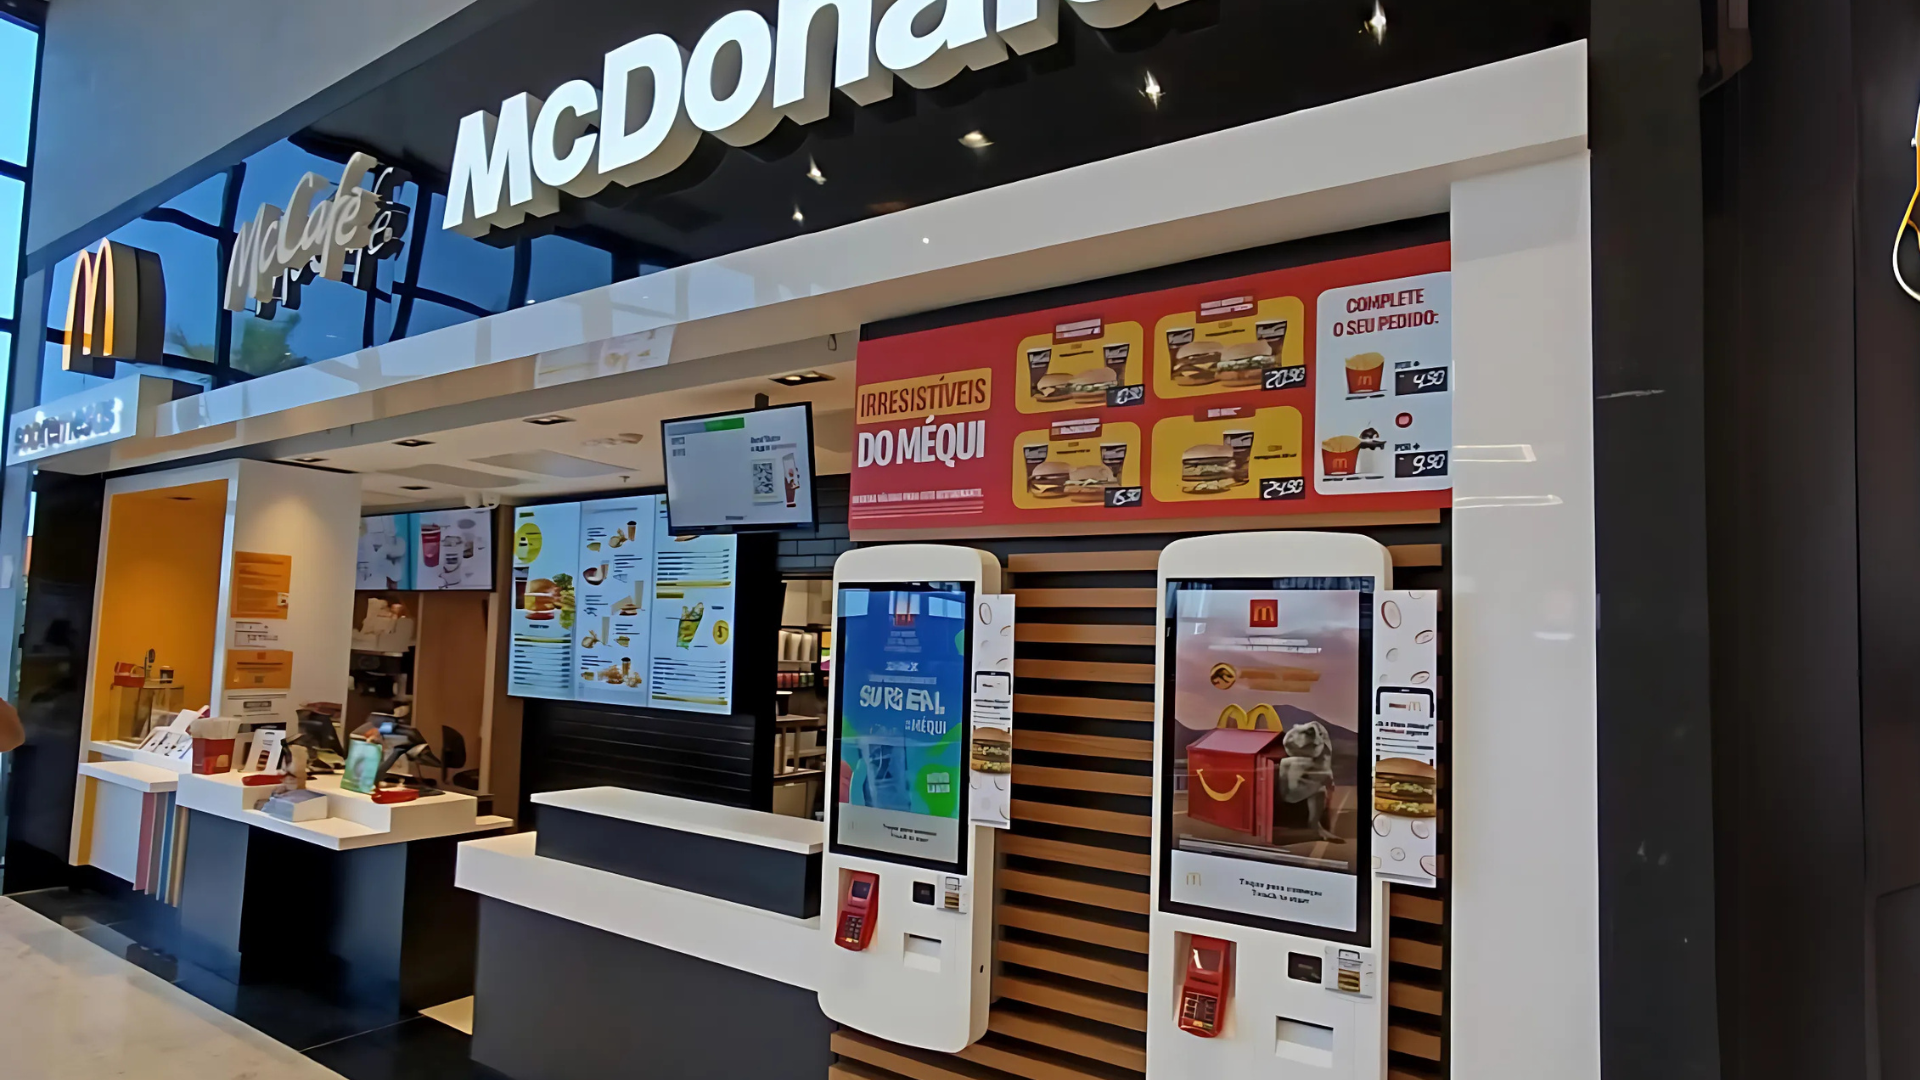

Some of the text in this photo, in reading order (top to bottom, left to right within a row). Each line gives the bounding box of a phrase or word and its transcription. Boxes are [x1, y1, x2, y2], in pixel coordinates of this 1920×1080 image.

[224, 151, 366, 310] McCafé
[1346, 288, 1425, 314] COMPLETE
[1333, 322, 1344, 337] O
[1346, 317, 1375, 336] SEU
[860, 375, 987, 418] IRRESISTÍVEIS
[857, 414, 986, 468] DO MÉQUI
